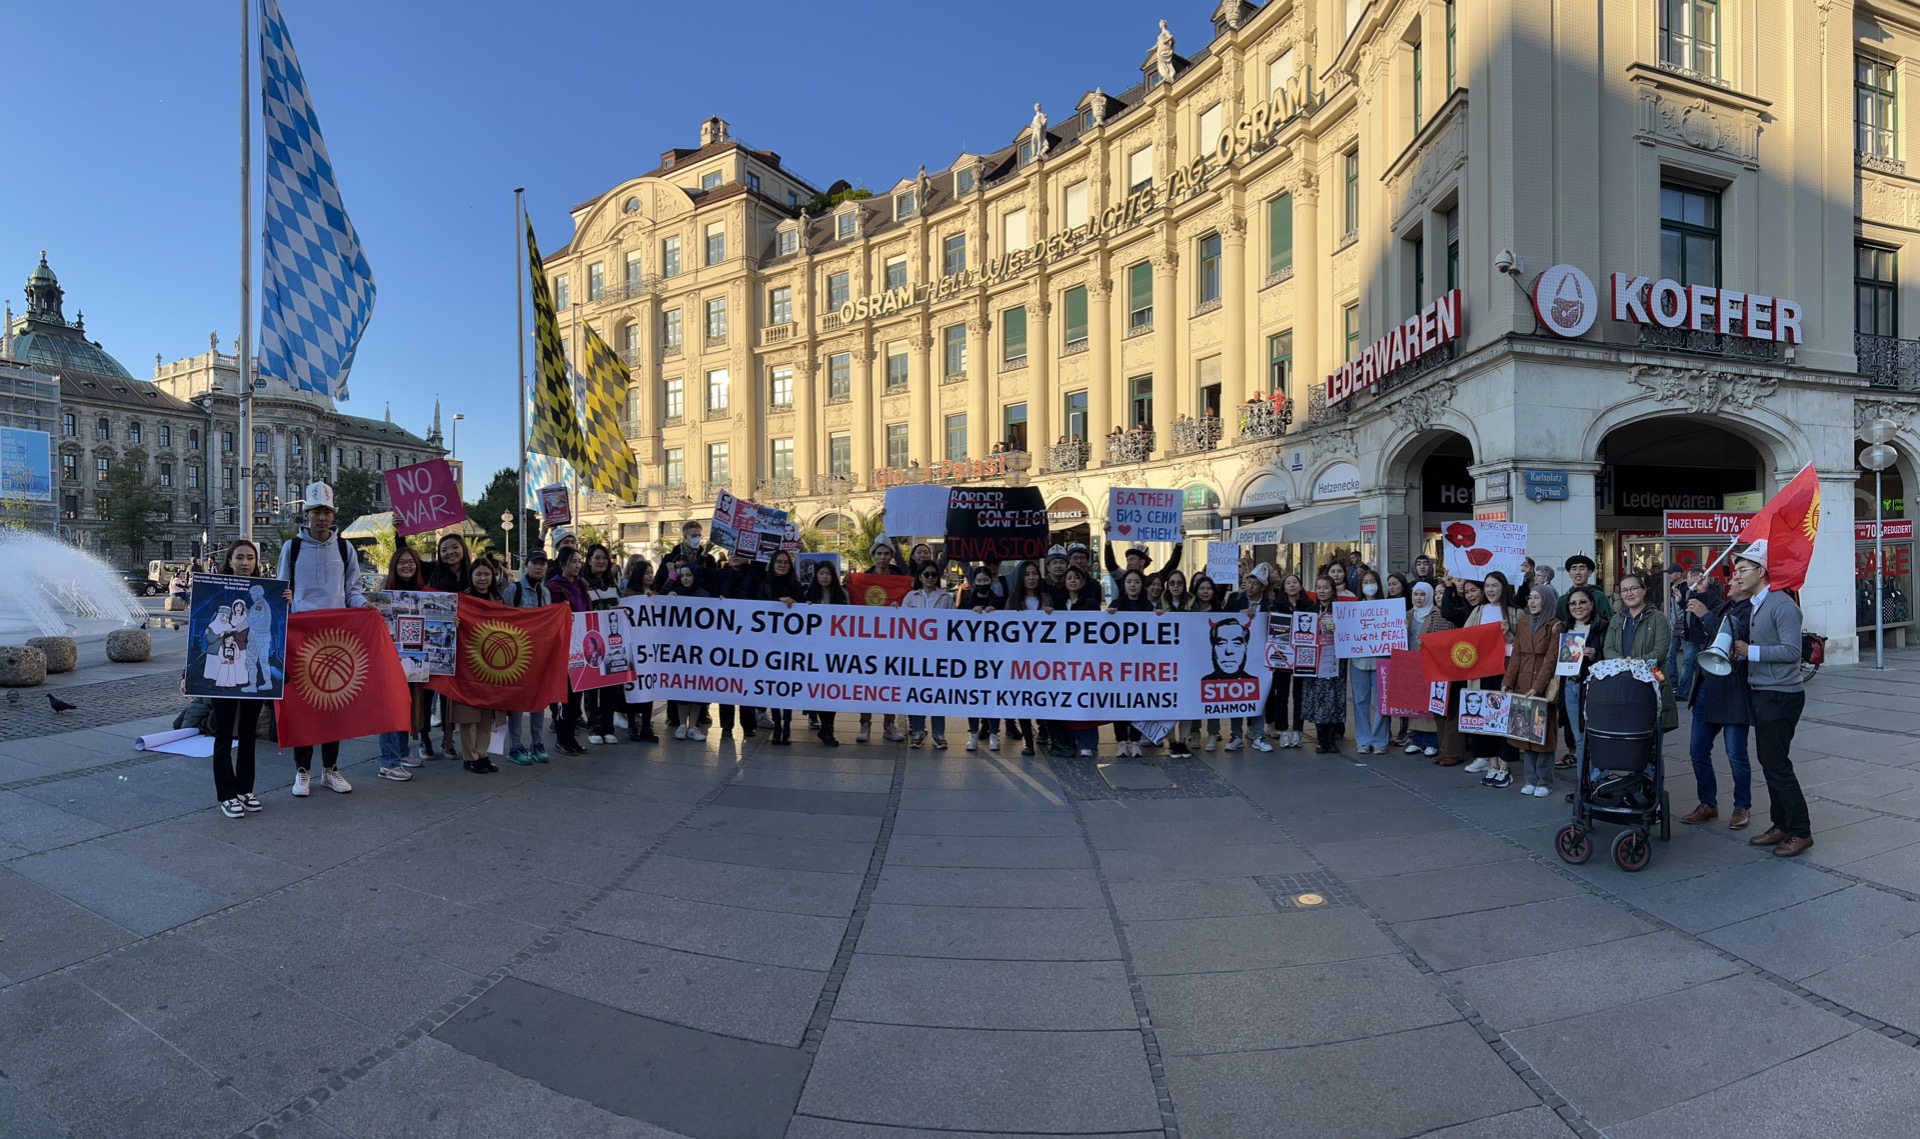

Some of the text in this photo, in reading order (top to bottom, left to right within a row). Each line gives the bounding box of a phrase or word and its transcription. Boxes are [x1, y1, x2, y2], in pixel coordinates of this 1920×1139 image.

[839, 63, 1313, 324] OSRAM HELL WIE DER LICHTE TAG OSRAM
[1611, 271, 1803, 345] KOFFER
[1325, 288, 1462, 408] LEDERWAREN
[396, 467, 433, 496] NO
[1530, 472, 1562, 483] Karlsplatz
[1318, 479, 1360, 494] Hetzenecke
[950, 490, 1004, 510] BORDER
[1116, 491, 1174, 507] БАТКЕН
[1246, 488, 1288, 502] Hetzenecker
[1623, 491, 1716, 509] Lederwaren
[977, 509, 1048, 528] CONFLICT
[1047, 510, 1082, 518] STARBUCKS
[1116, 509, 1177, 524] БИЗ СЕНИ
[1480, 521, 1524, 533] KYRGYZSTAN
[1667, 519, 1713, 529] EINZELTEILE
[1714, 516, 1739, 533] 70%
[1883, 524, 1912, 535] REDUZIERT
[1236, 530, 1278, 543] Lederwaren
[947, 536, 1049, 559] INVASION
[1208, 542, 1234, 554] STOP
[1493, 545, 1526, 555] INITIATOR
[750, 610, 823, 635] STOP
[830, 614, 938, 641] KILLING
[946, 619, 1057, 644] KYRGYZ
[1065, 621, 1180, 645] PEOPLE!
[1381, 629, 1405, 641] PEACE
[609, 637, 622, 645] STOP
[1350, 645, 1364, 653] not
[637, 643, 1178, 682] 5-YEAR OLD GIRL WAS KILLED BY MORTAR FIRE!
[659, 673, 748, 697] RAHMON,
[754, 679, 803, 698] STOP
[807, 682, 901, 702] VIOLENCE
[906, 687, 991, 707] AGAINST
[996, 690, 1072, 709] KYRGYZ
[1077, 692, 1178, 709] CIVILIANS!
[1204, 681, 1256, 700] STOP
[1204, 702, 1256, 714] RAHMON
[1461, 717, 1484, 725] STOP
